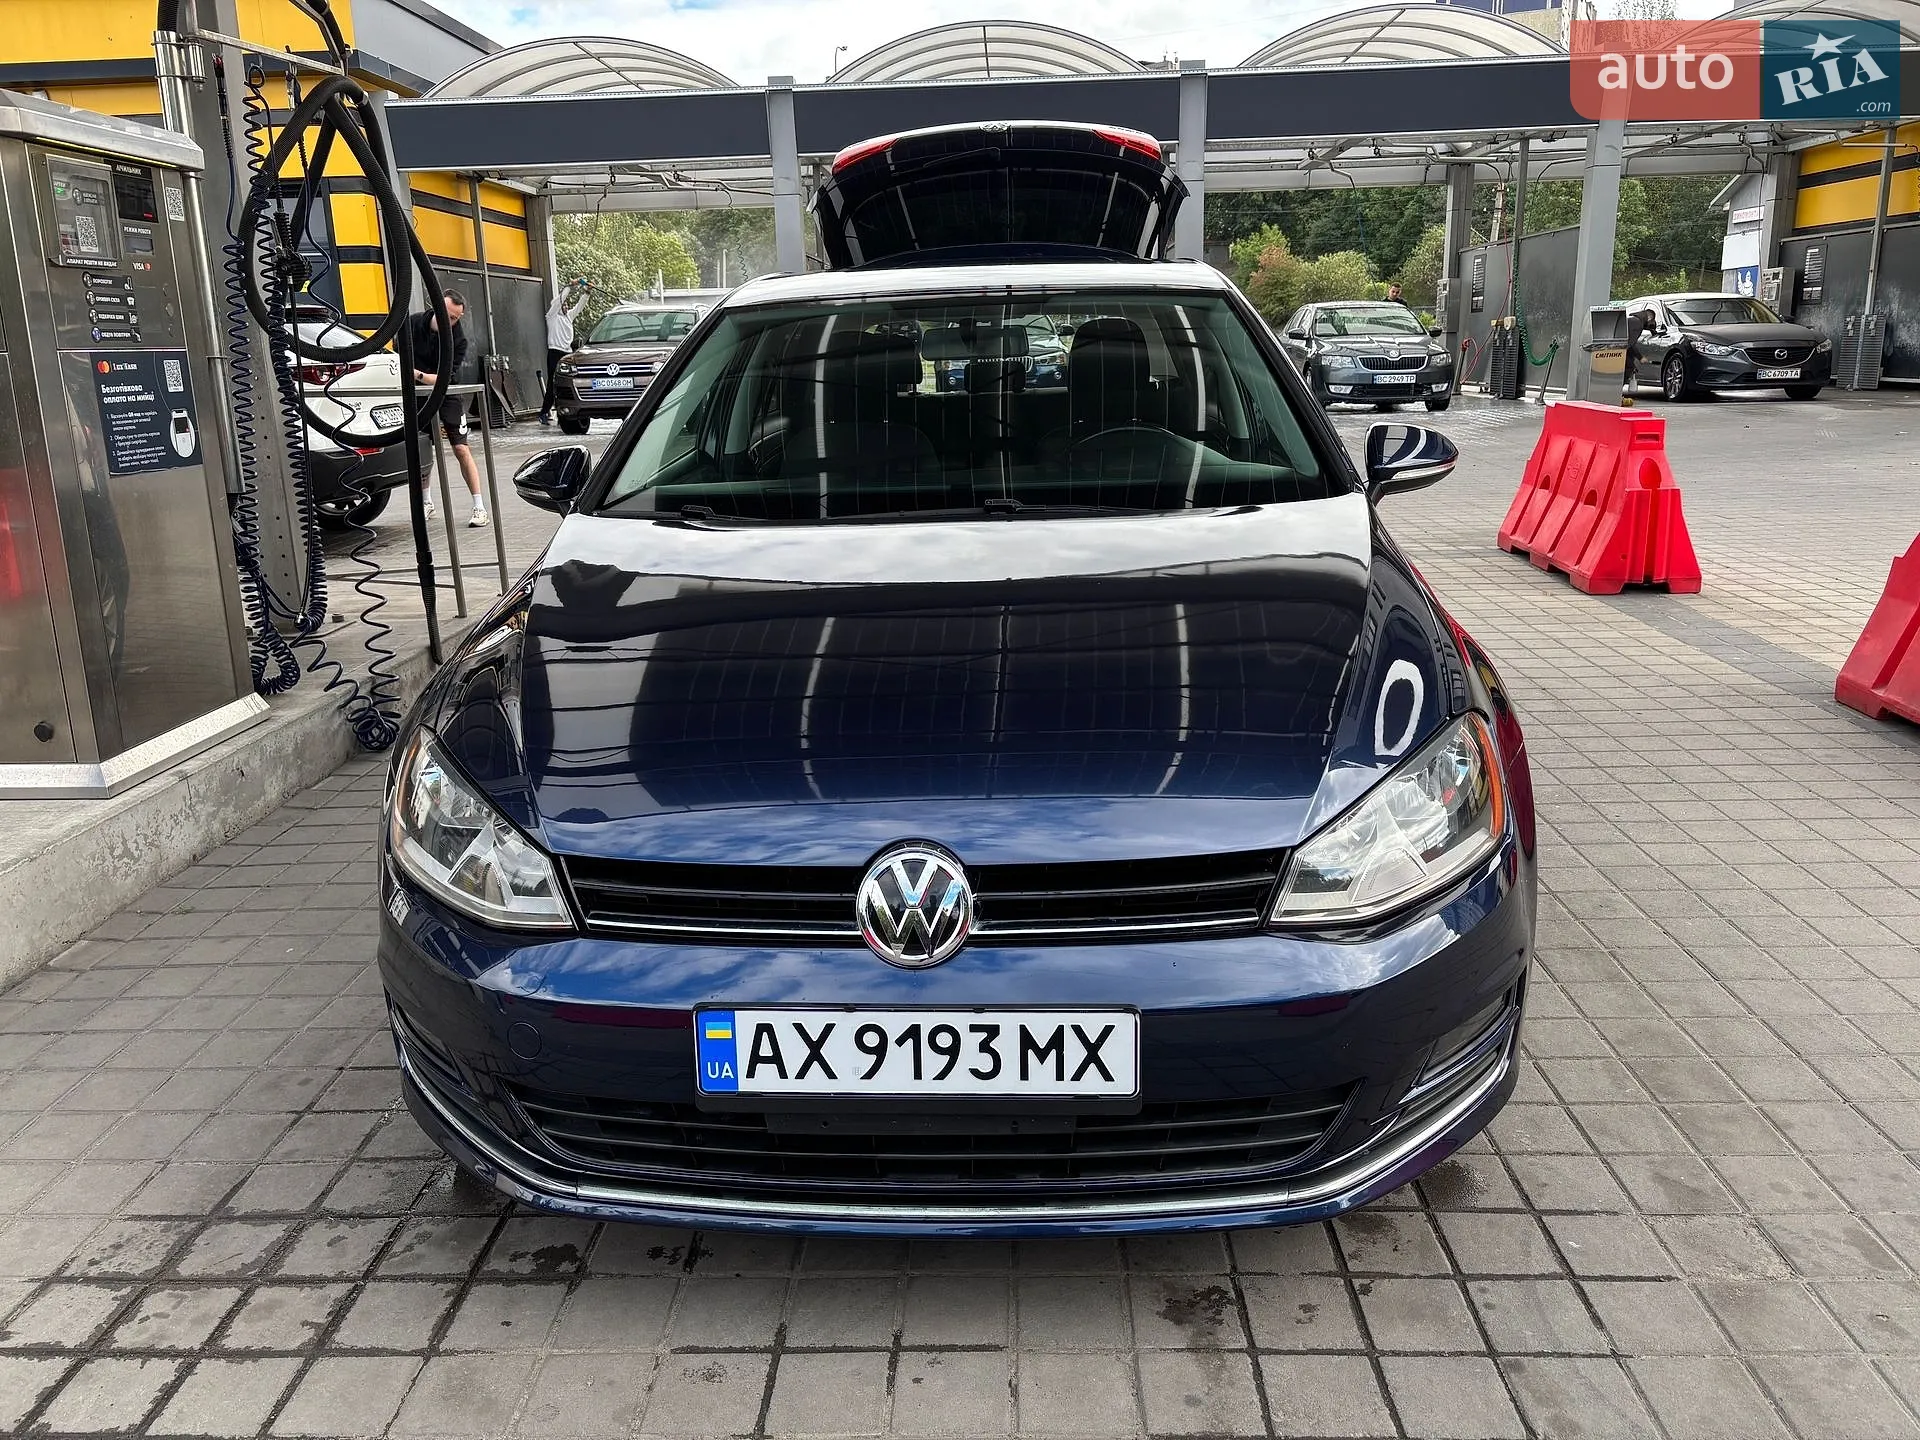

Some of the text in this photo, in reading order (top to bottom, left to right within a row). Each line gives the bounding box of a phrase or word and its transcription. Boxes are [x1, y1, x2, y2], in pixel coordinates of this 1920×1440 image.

[133, 262, 145, 271] VISA
[104, 396, 127, 404] оплата
[744, 1022, 1116, 1082] AX 9193 MX
[707, 1061, 735, 1079] UA
